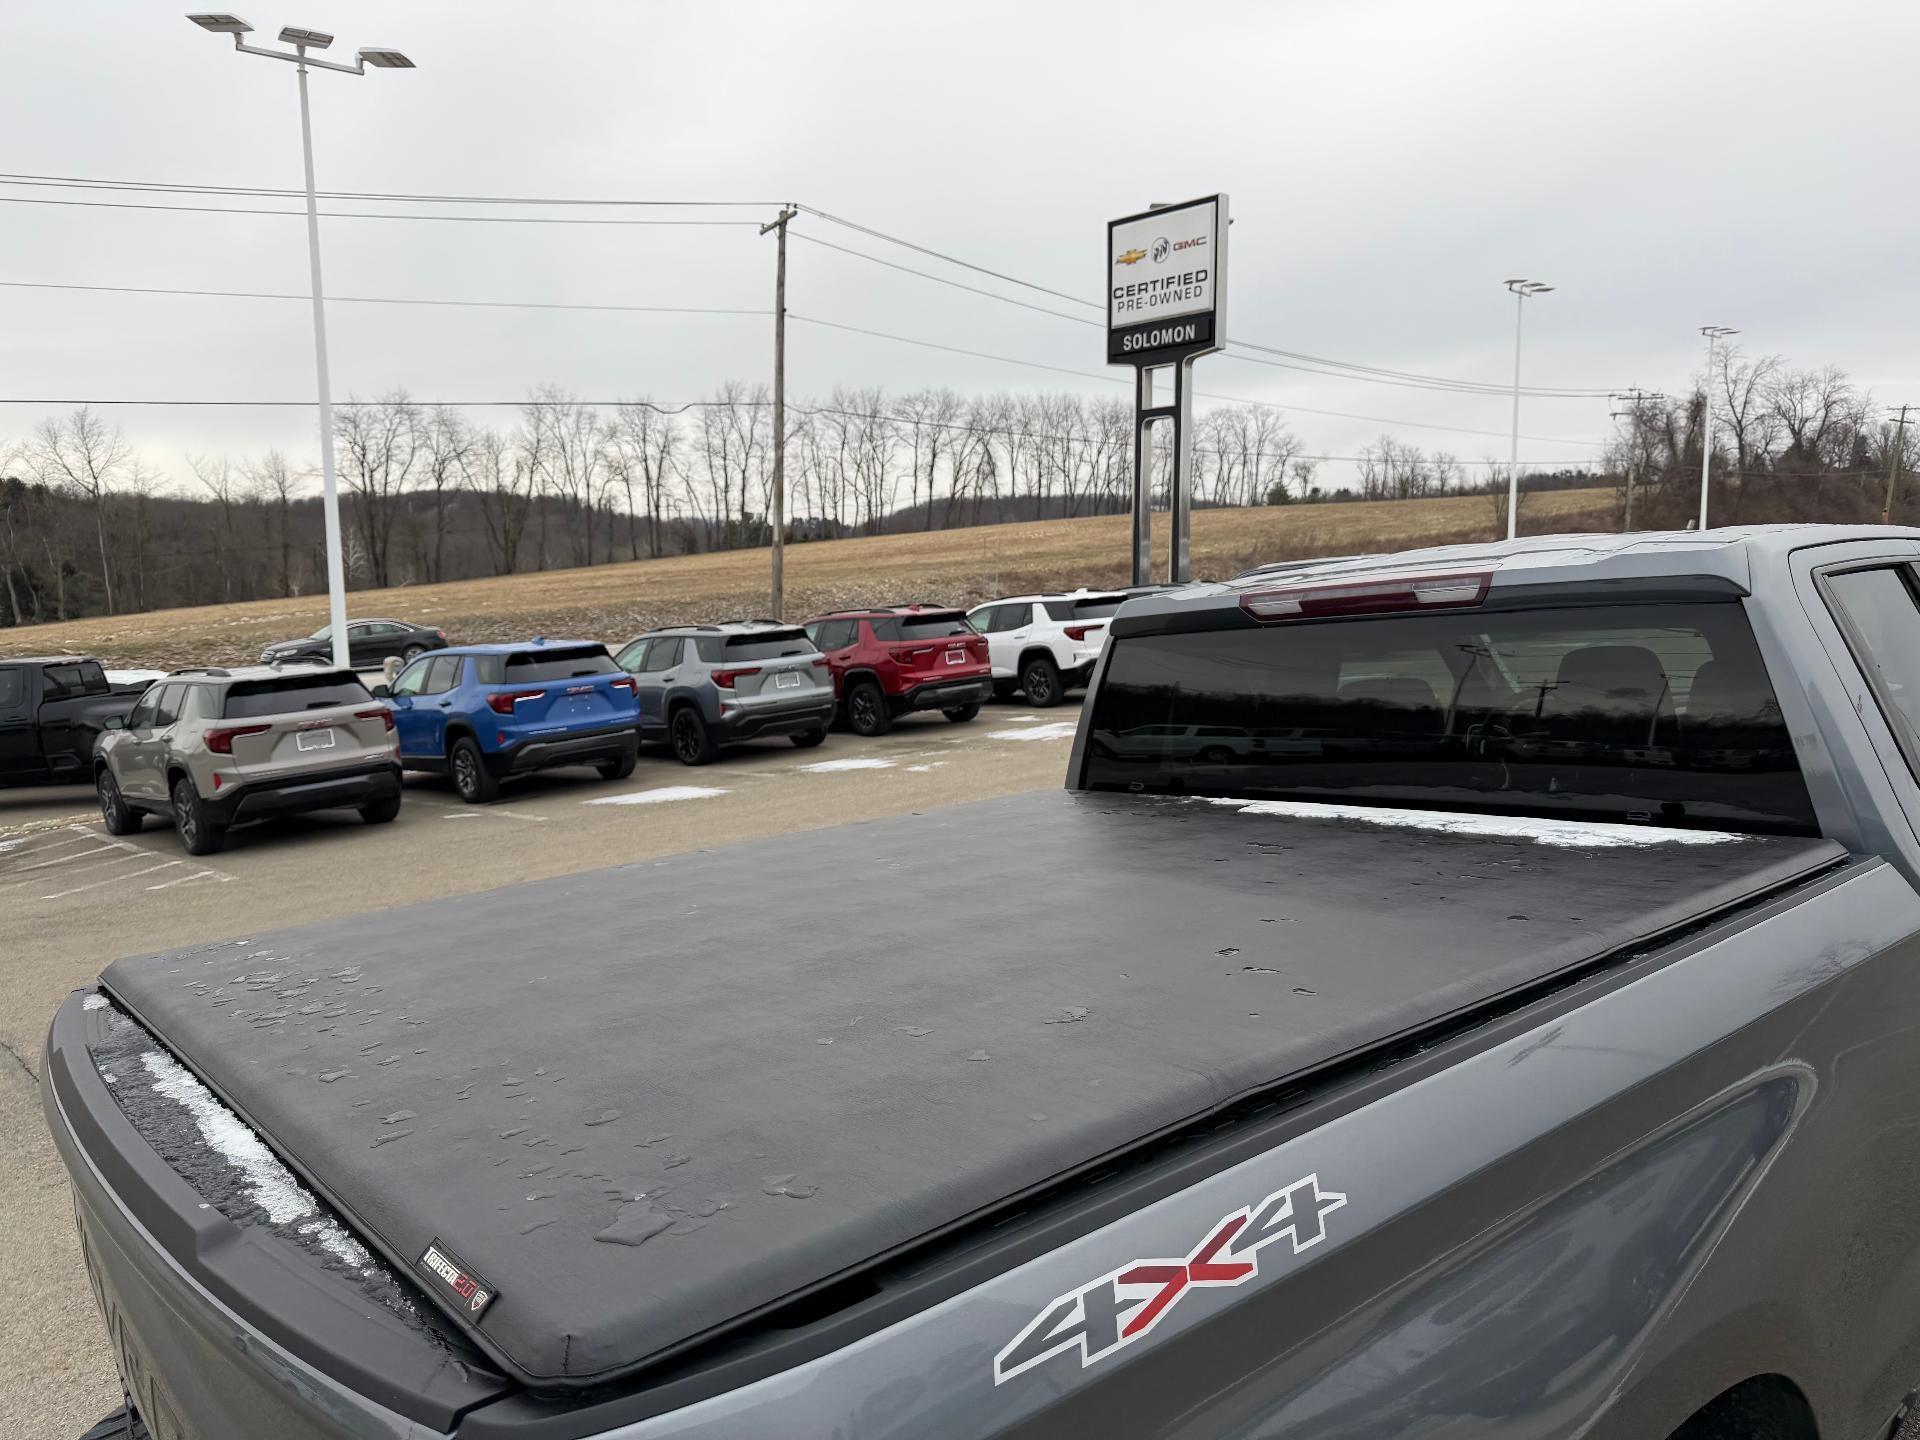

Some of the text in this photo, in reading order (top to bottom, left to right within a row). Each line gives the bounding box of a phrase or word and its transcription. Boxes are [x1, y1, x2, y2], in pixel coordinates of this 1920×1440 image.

[1173, 236, 1207, 252] GMC
[1113, 269, 1208, 299] CERTIFIED
[1117, 285, 1202, 313] PRE-OWNED
[1123, 324, 1196, 351] SOLOMON
